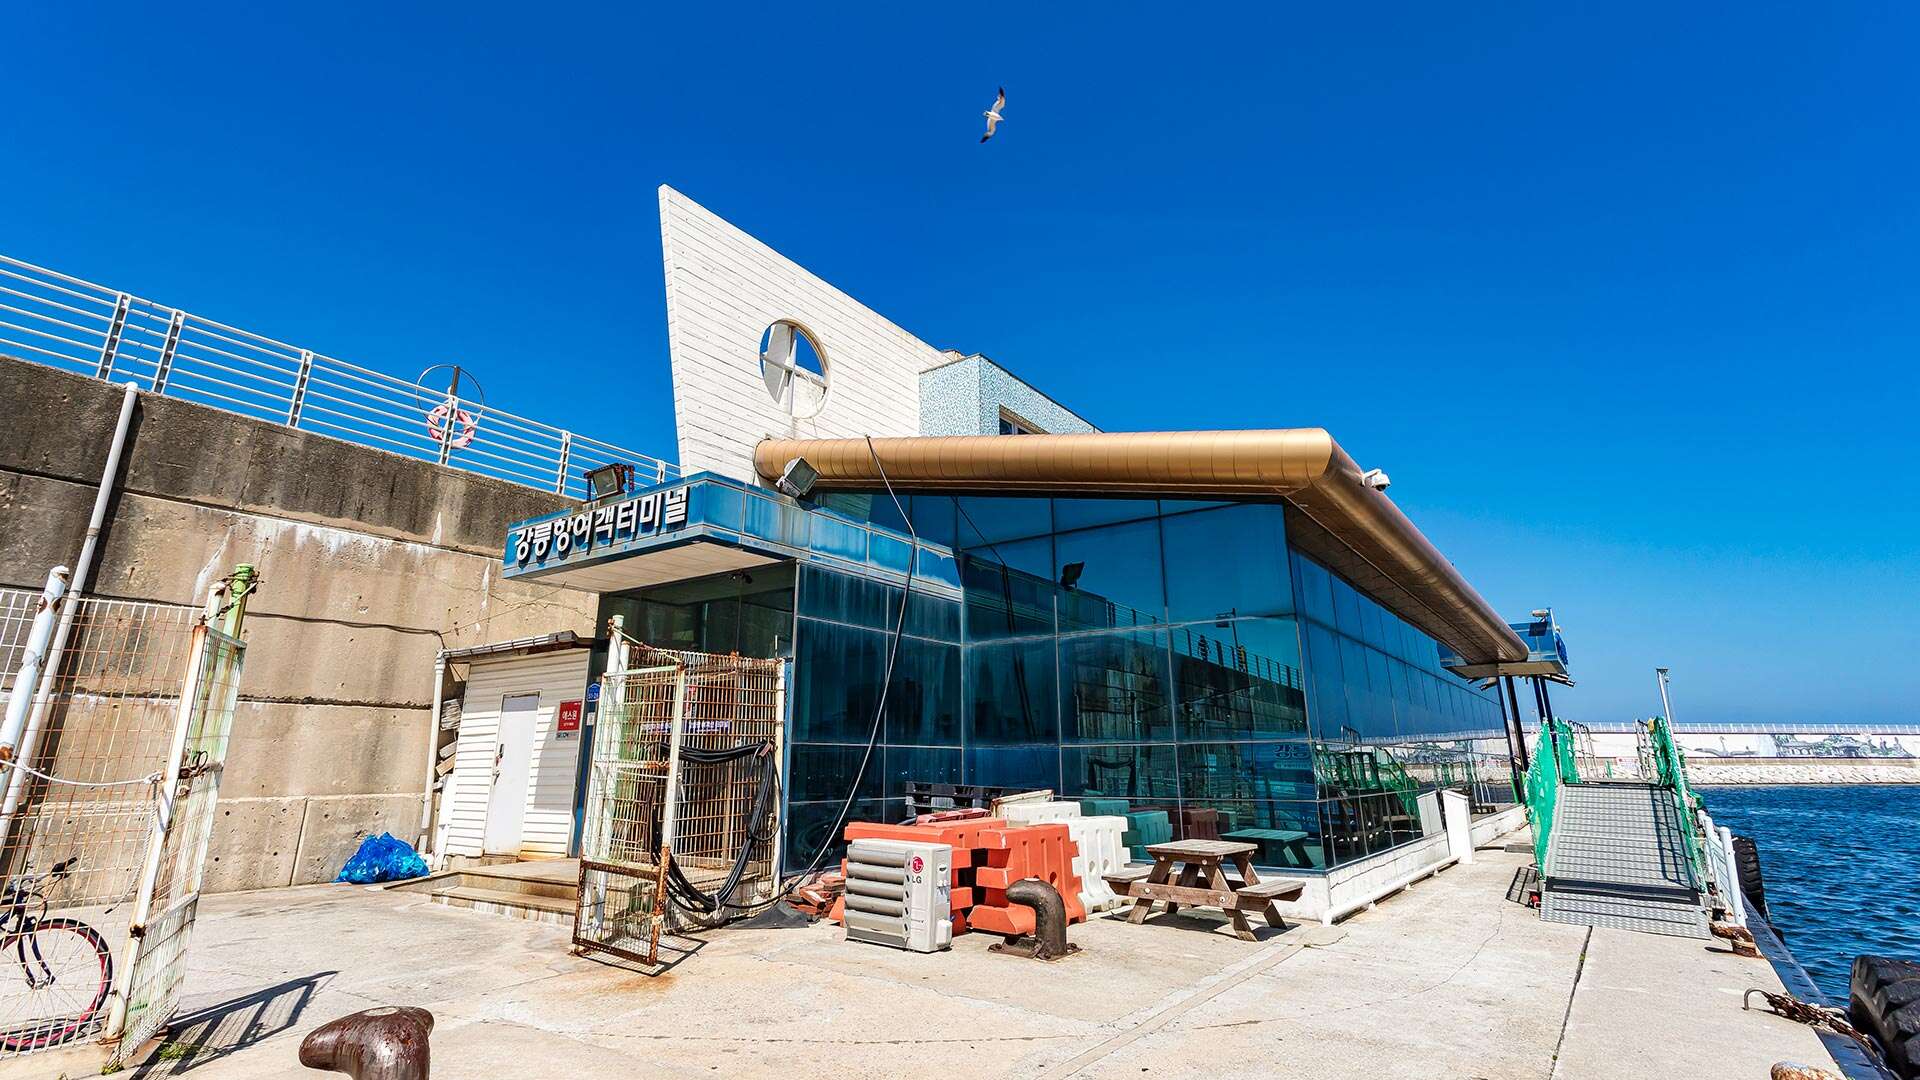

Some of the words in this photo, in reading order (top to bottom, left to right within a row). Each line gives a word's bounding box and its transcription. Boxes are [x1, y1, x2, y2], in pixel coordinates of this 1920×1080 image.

[515, 486, 689, 561] 강릉항여객터미널
[562, 710, 577, 720] 에스원
[911, 875, 922, 884] LG
